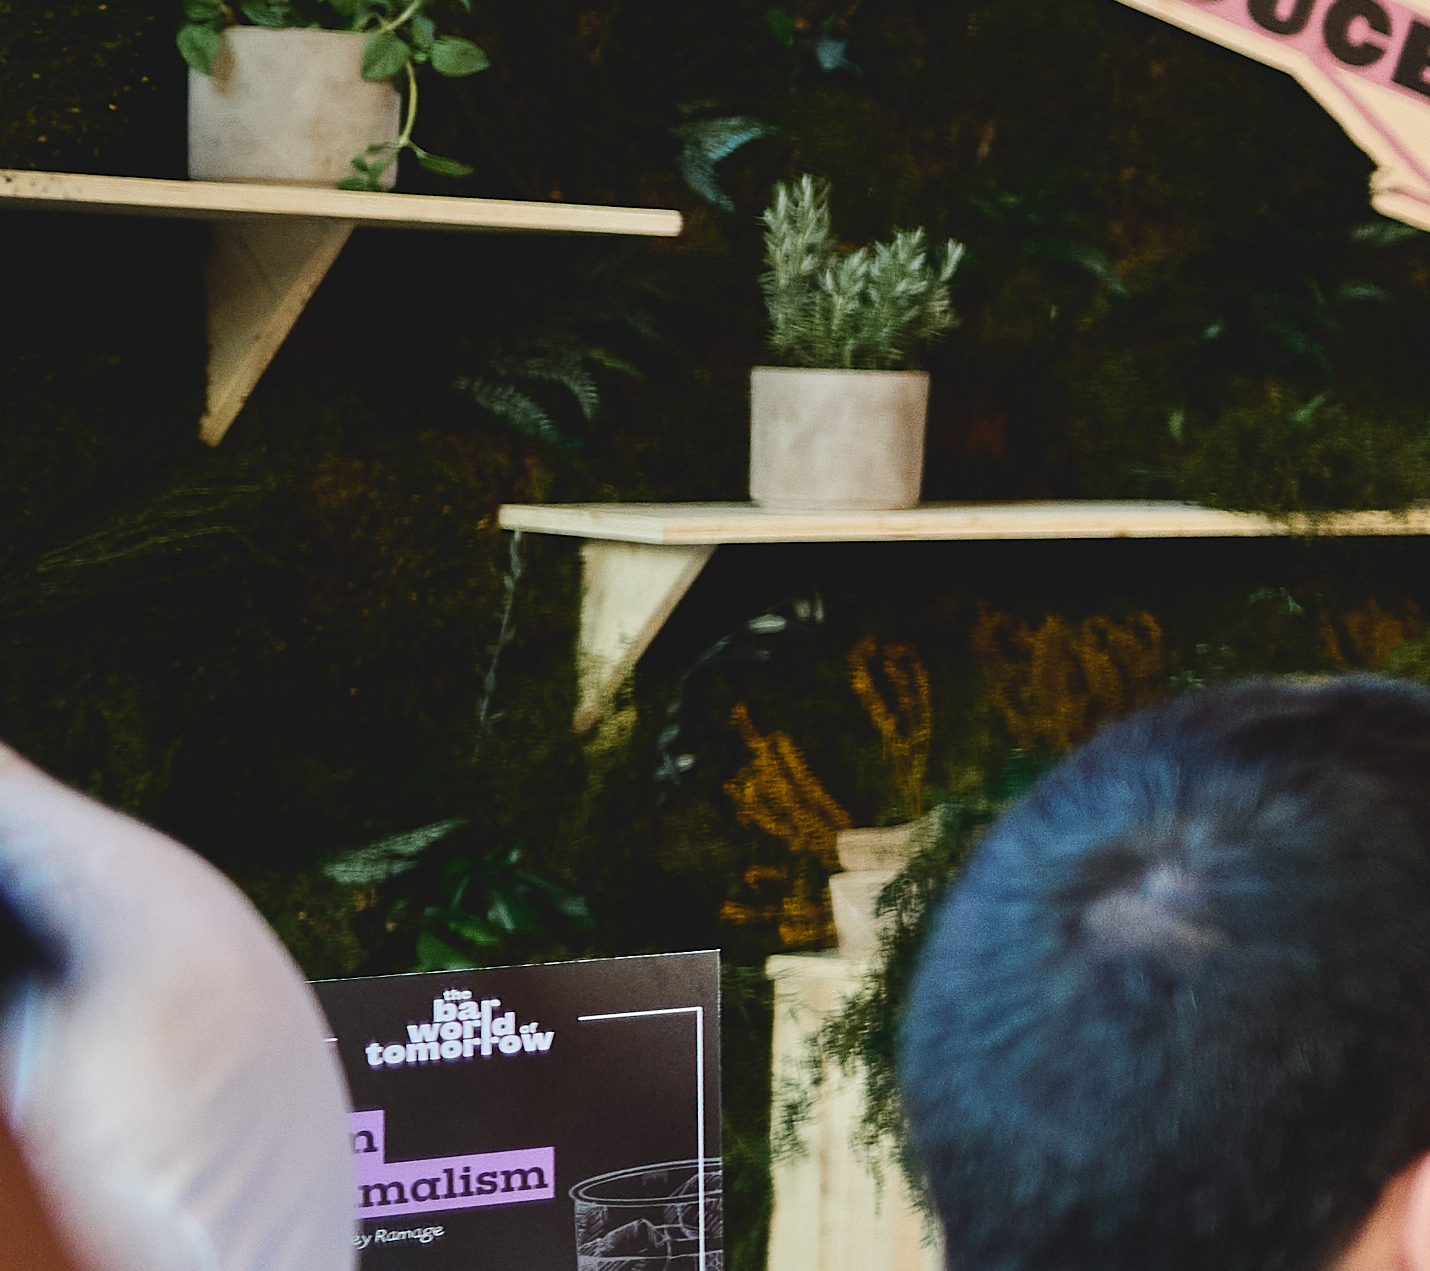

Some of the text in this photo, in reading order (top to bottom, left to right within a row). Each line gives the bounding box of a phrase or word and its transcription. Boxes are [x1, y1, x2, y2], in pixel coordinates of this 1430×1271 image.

[443, 989, 473, 1001] the
[433, 998, 502, 1023] bar
[406, 1011, 539, 1044] world of
[365, 1031, 555, 1066] tomorrow
[359, 1166, 549, 1208] malism
[374, 1225, 446, 1244] Ramage
